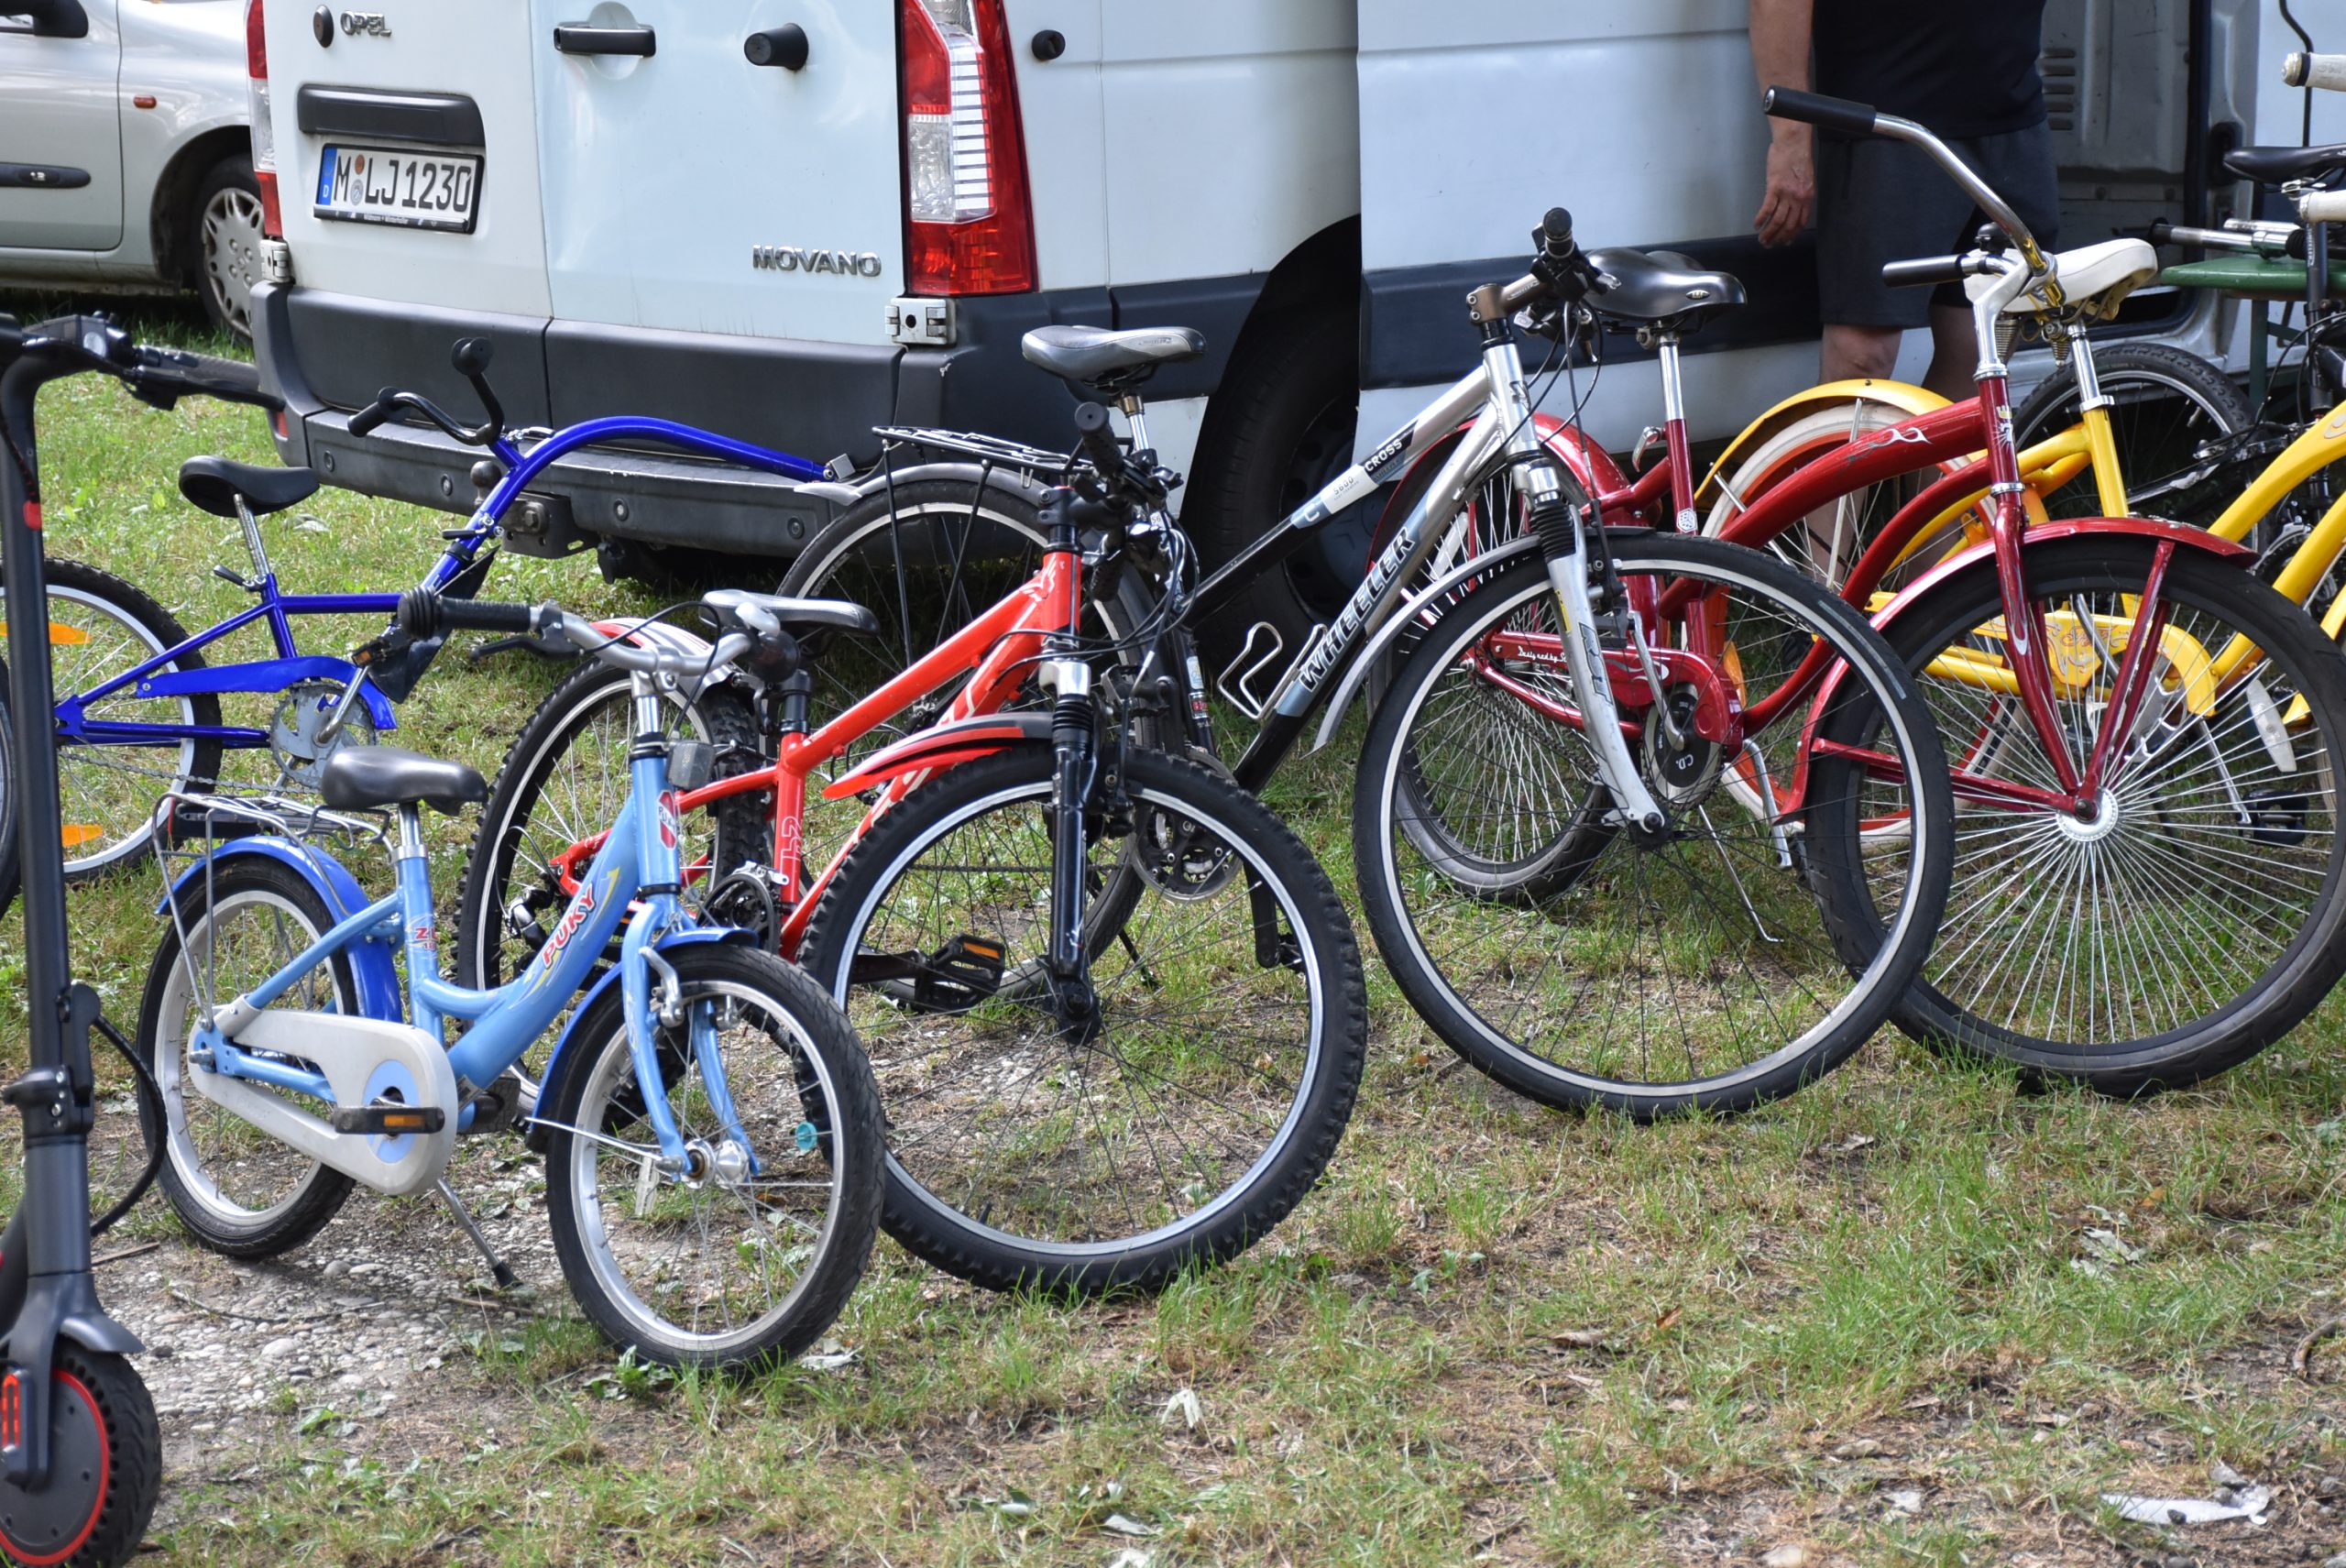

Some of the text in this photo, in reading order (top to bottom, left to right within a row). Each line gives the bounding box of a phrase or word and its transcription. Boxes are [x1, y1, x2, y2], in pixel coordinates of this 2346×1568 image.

[340, 10, 392, 38] OPEL
[323, 184, 330, 198] D
[334, 155, 472, 213] M LJ 1230
[752, 244, 882, 278] MOVANO
[1364, 438, 1403, 472] CROSS
[1299, 525, 1416, 693] WHEELER
[542, 882, 596, 969] PUKY
